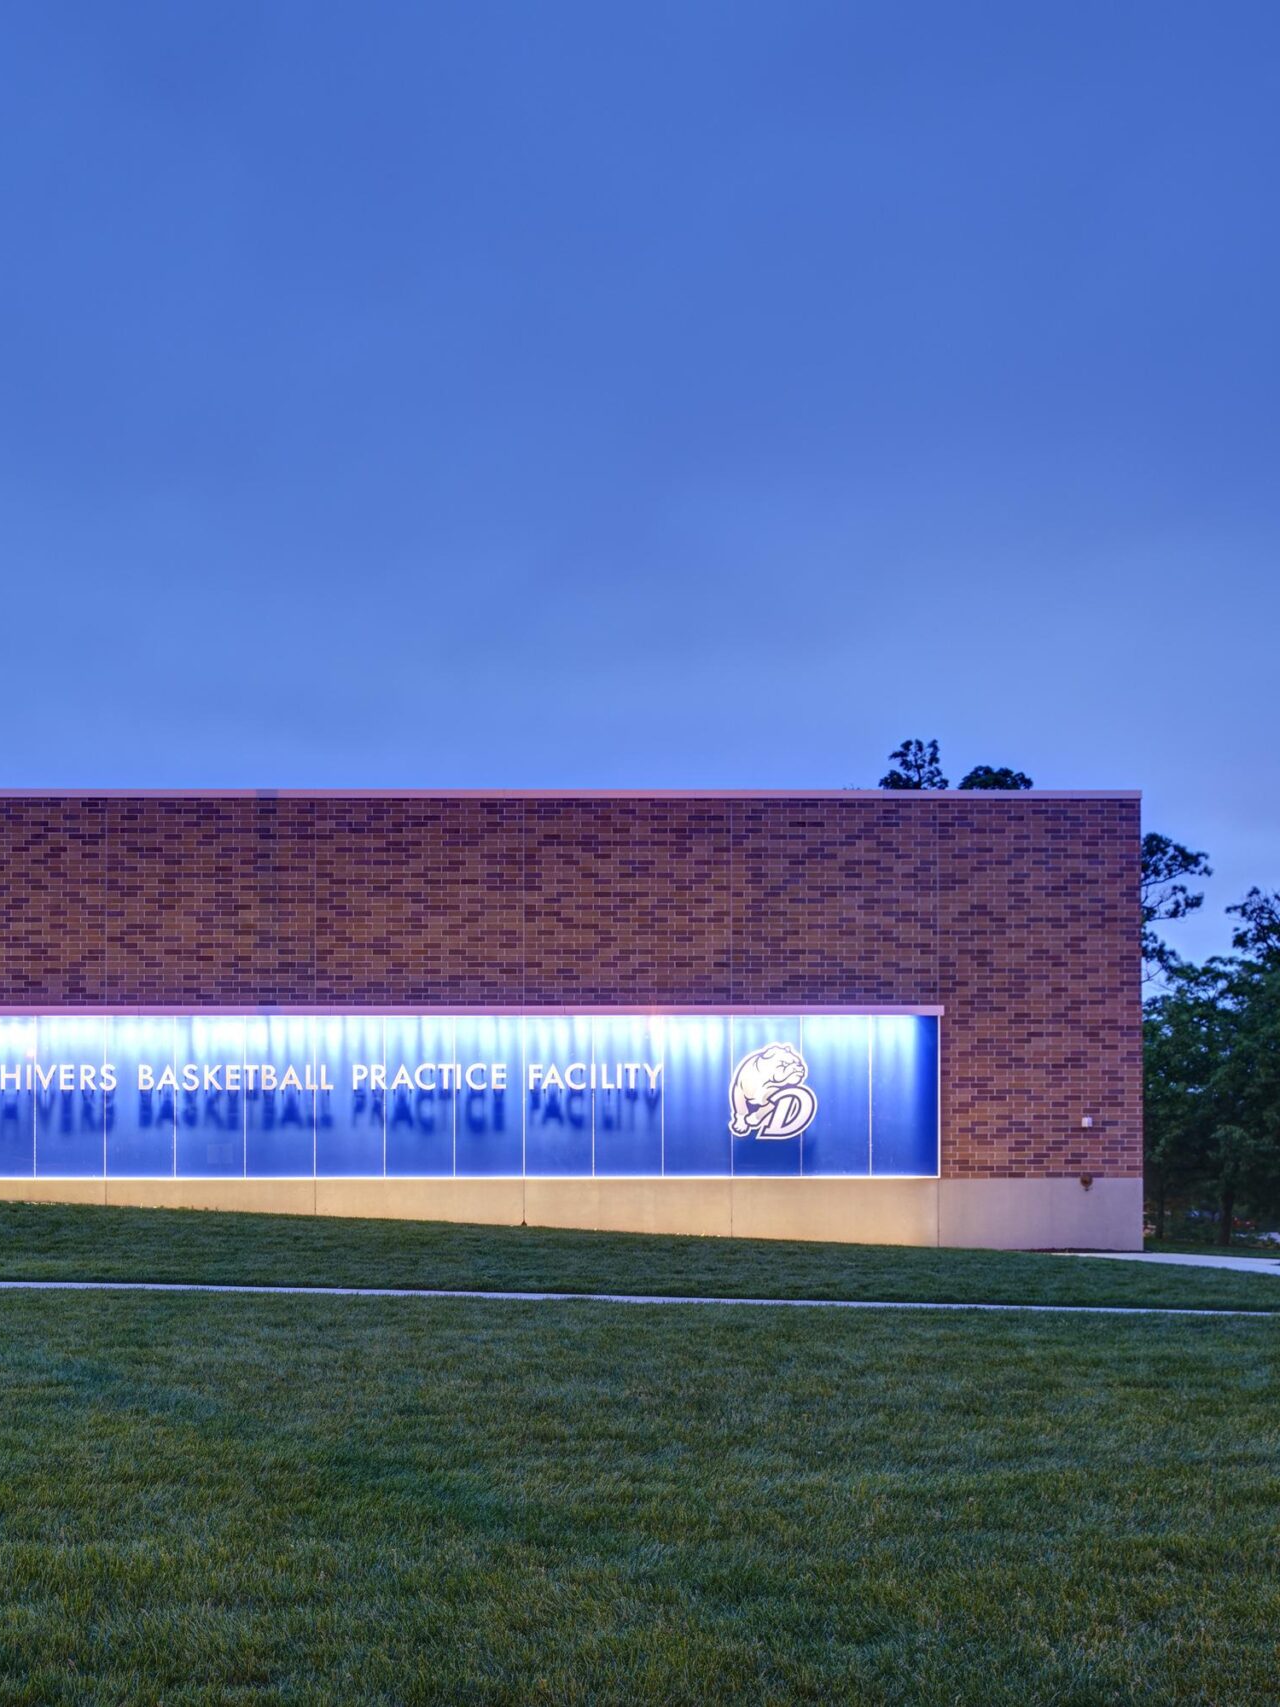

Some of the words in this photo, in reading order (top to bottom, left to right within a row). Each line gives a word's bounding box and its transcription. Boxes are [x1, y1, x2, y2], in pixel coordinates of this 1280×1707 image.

[138, 1063, 334, 1091] BASKETBALL
[352, 1063, 507, 1091] PRACTICE
[528, 1063, 663, 1091] FACILITY
[757, 1085, 816, 1138] D
